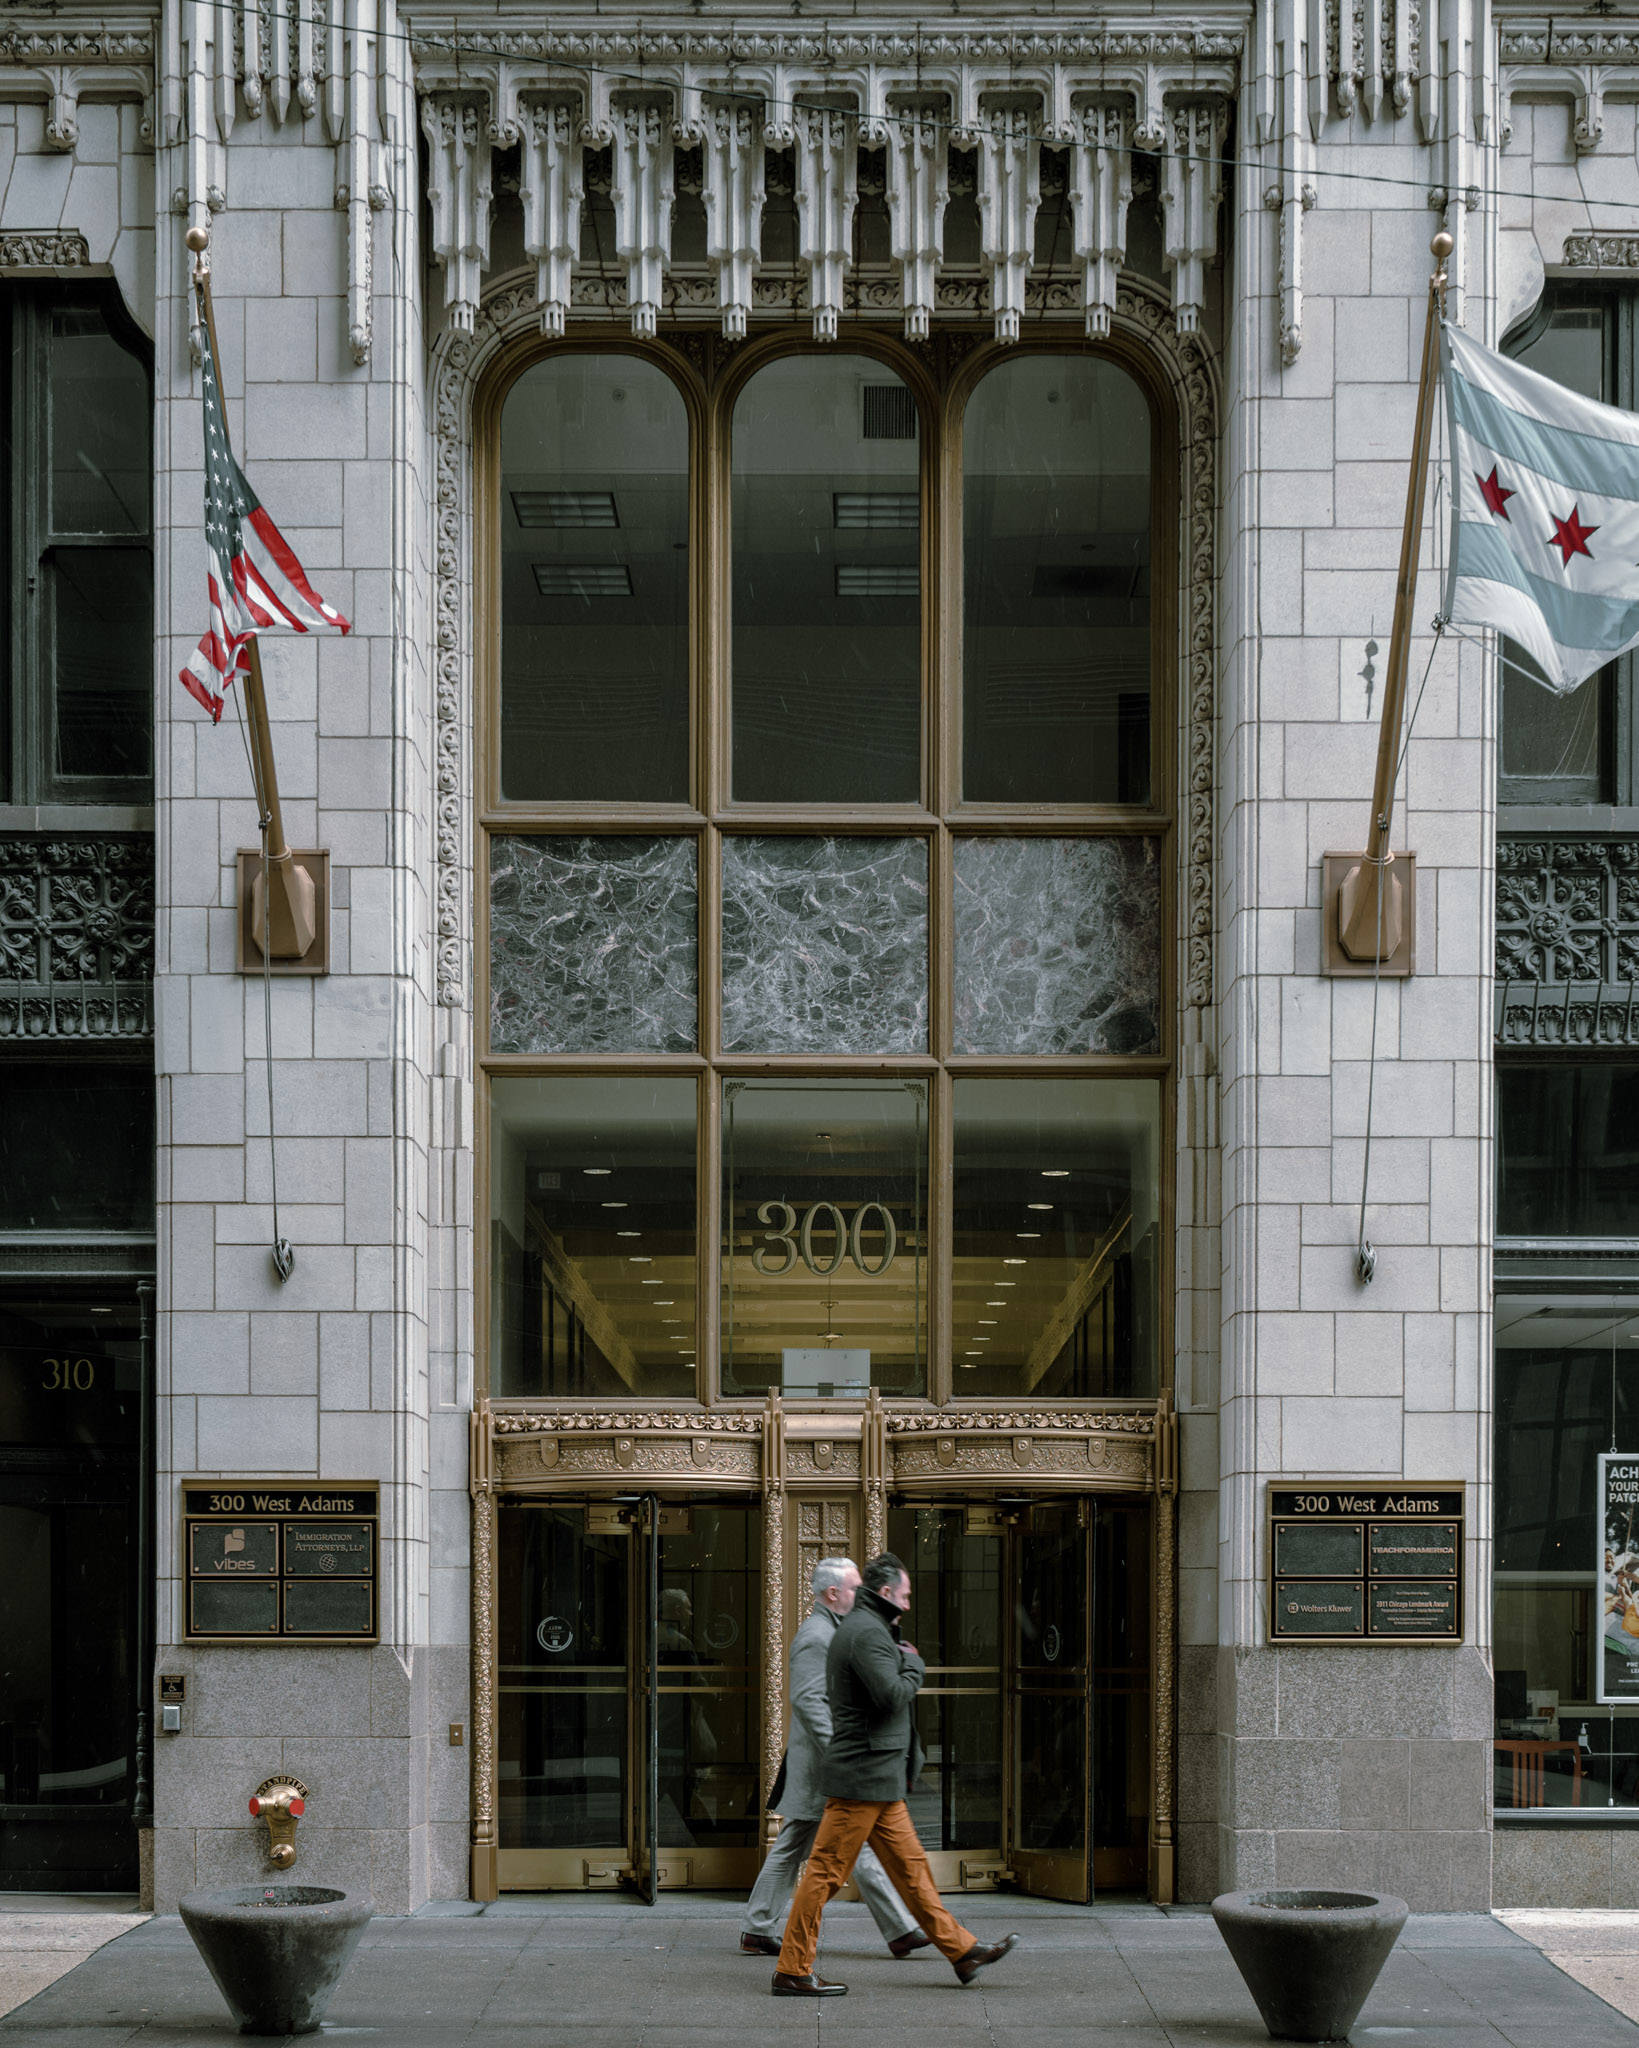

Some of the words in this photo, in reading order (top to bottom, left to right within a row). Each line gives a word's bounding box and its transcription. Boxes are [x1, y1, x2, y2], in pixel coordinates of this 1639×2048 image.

[752, 1201, 897, 1277] 300
[42, 1358, 94, 1390] 310
[1608, 1481, 1639, 1492] YOUR
[209, 1495, 245, 1511] 300
[252, 1496, 291, 1511] West
[298, 1495, 354, 1512] Adams
[1294, 1496, 1330, 1512] 300
[1337, 1496, 1376, 1512] West
[1383, 1496, 1439, 1512] Adams
[349, 1544, 365, 1552] LLP
[214, 1558, 256, 1571] vibes
[1300, 1605, 1327, 1613] Wolters
[1328, 1605, 1352, 1613] Kluwer
[257, 1776, 306, 1796] STANDPIPE
